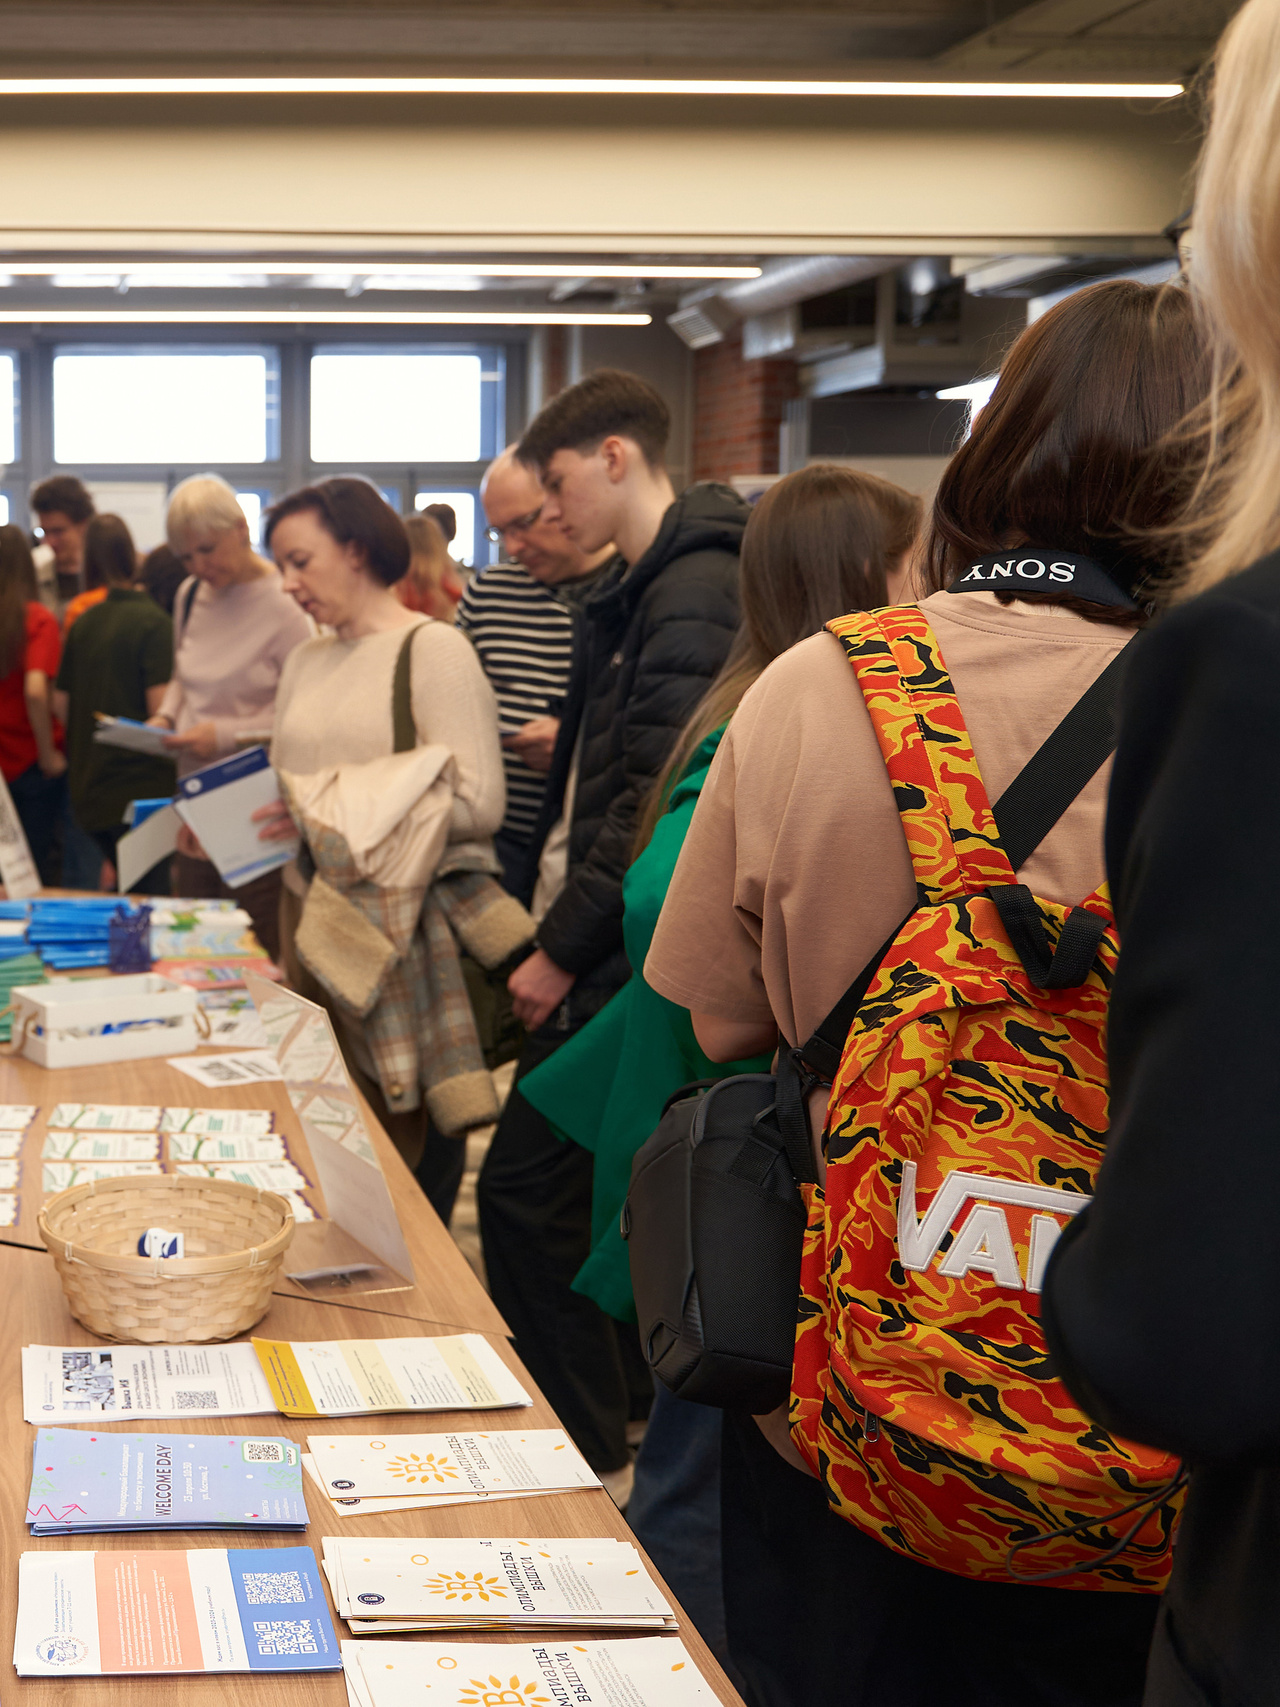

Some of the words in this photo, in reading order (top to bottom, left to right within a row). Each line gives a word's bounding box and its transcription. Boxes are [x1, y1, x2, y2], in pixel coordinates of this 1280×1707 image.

[960, 558, 1076, 583] SONY
[156, 1444, 172, 1466] DAY
[155, 1468, 172, 1517] WELCOME
